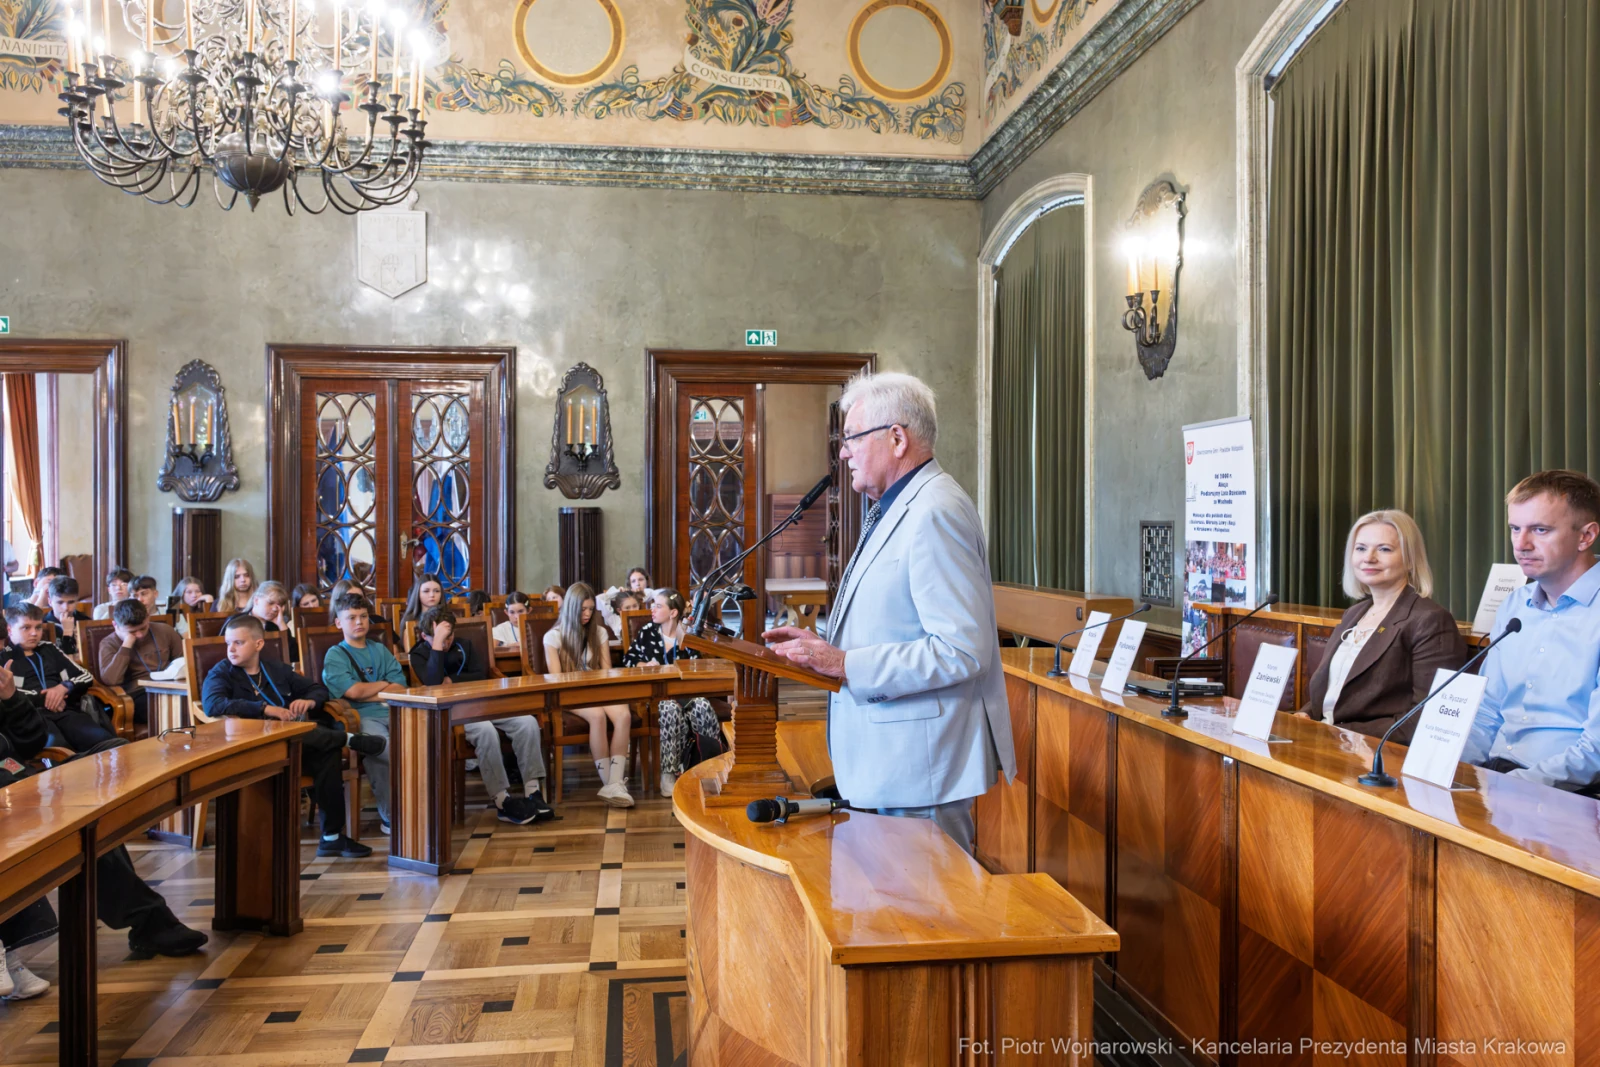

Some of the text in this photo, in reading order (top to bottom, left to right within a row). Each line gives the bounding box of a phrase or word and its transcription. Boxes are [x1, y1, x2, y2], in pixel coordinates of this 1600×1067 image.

[691, 63, 786, 92] CONSCIENTIA
[1256, 672, 1282, 684] Zaniewski
[1449, 694, 1468, 704] Ryszard
[1438, 704, 1461, 718] Gacek
